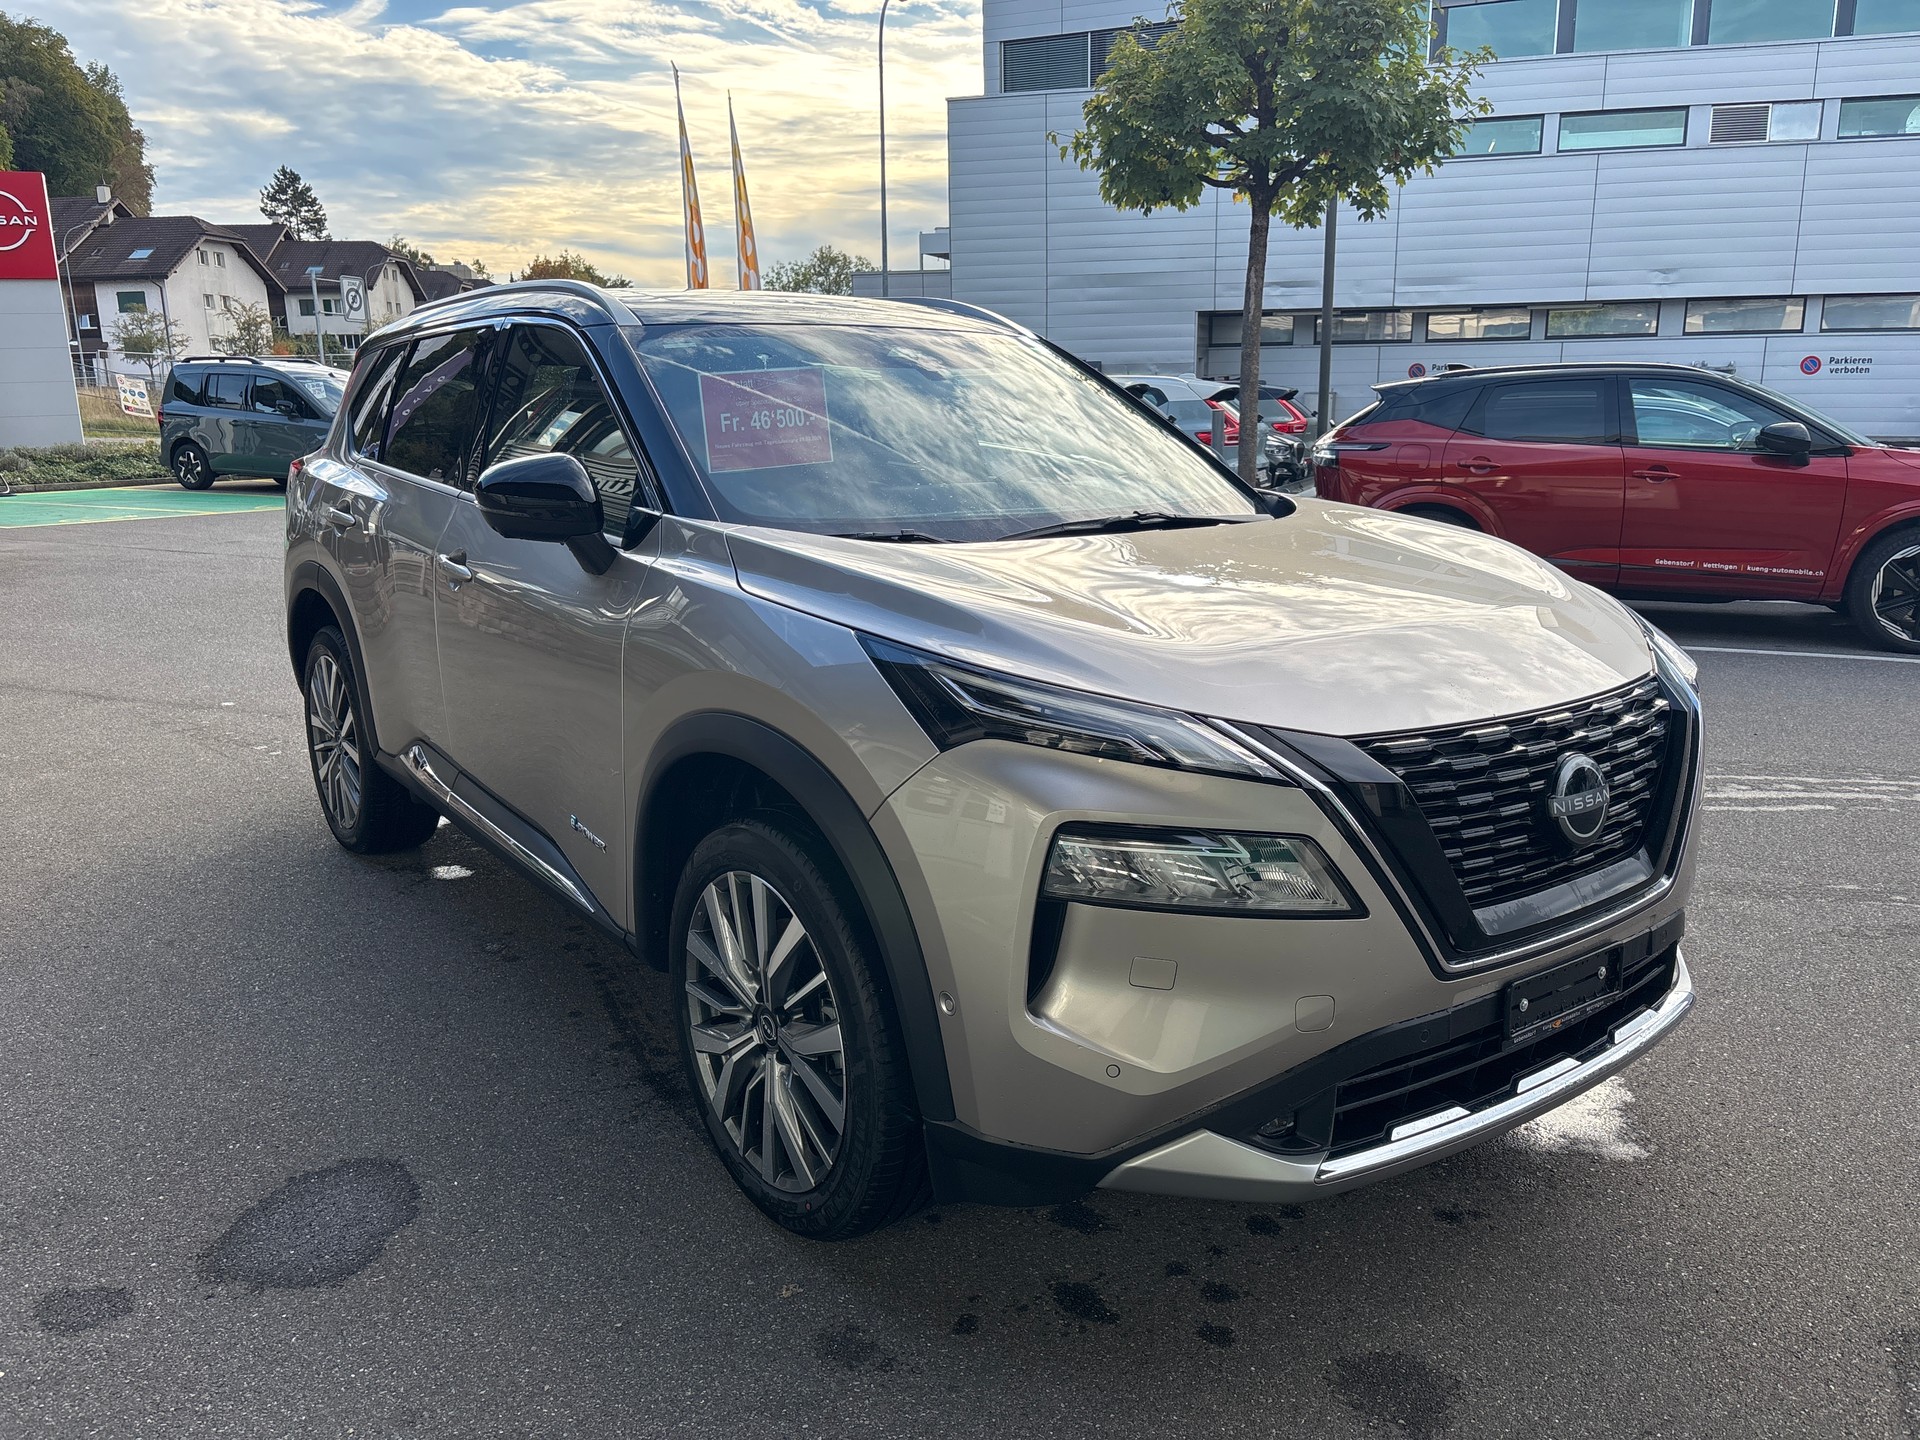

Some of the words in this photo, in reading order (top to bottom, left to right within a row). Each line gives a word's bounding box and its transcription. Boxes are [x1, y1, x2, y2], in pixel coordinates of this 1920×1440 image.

[0, 215, 38, 226] SAN
[1829, 356, 1873, 365] Parkieren
[1431, 363, 1449, 371] Park
[1829, 366, 1871, 374] verboten
[720, 412, 745, 433] Fr.
[1655, 558, 1695, 567] Gebenstorf
[1703, 562, 1738, 571] Wettingen
[1746, 565, 1824, 577] kueng-automobile.ch
[1552, 789, 1610, 815] NISSAN
